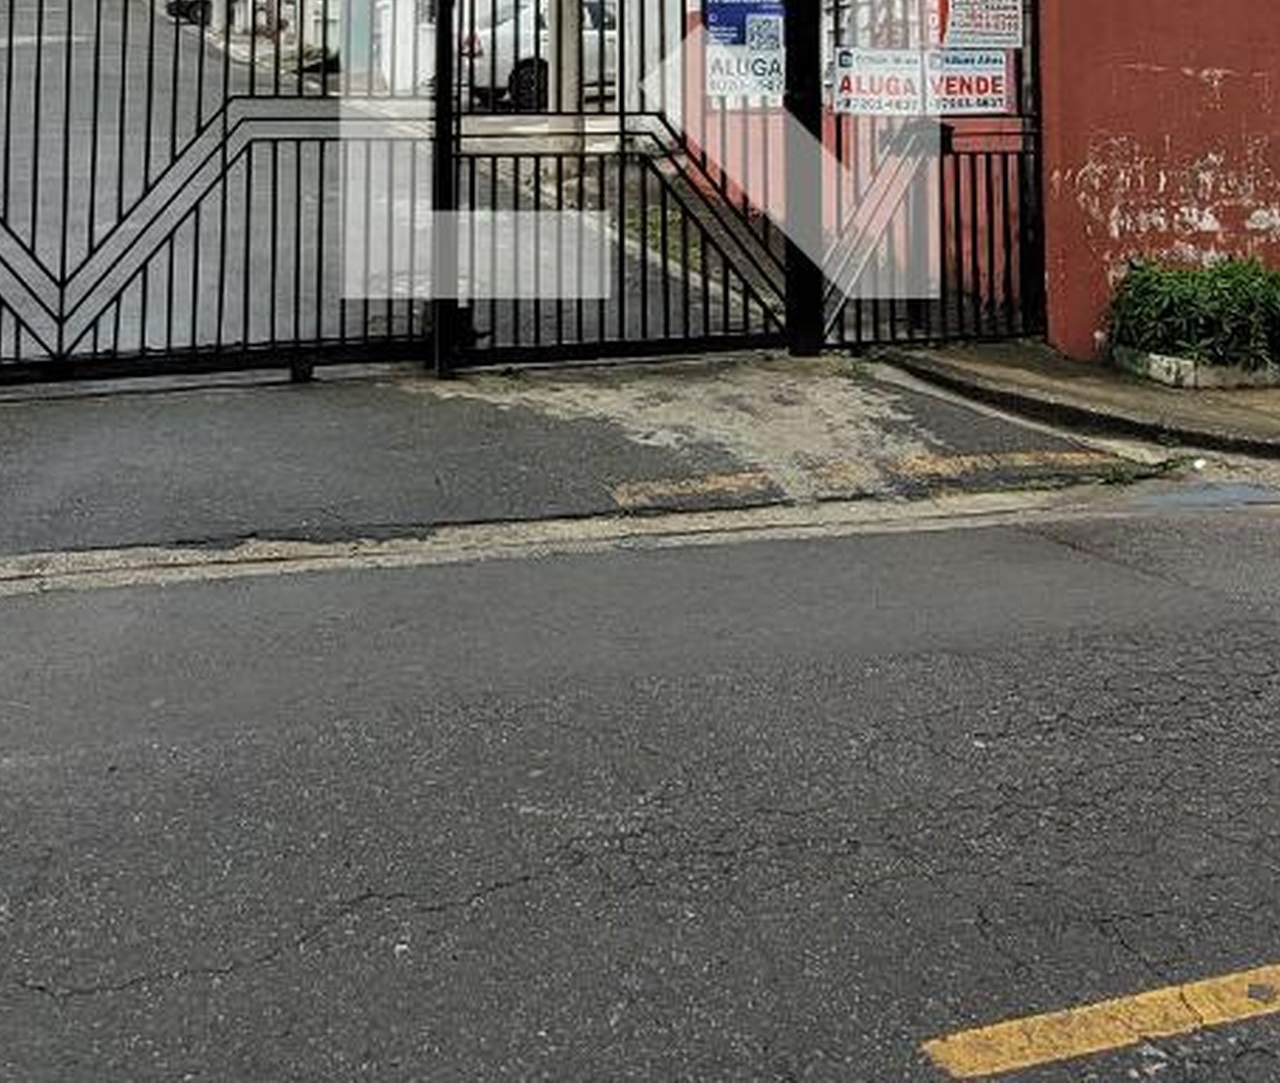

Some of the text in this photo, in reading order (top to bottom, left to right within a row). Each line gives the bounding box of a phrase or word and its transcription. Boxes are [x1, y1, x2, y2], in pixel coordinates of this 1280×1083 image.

[711, 57, 783, 77] ALUGA
[838, 74, 918, 97] ALUGA
[929, 74, 1004, 96] VENDE
